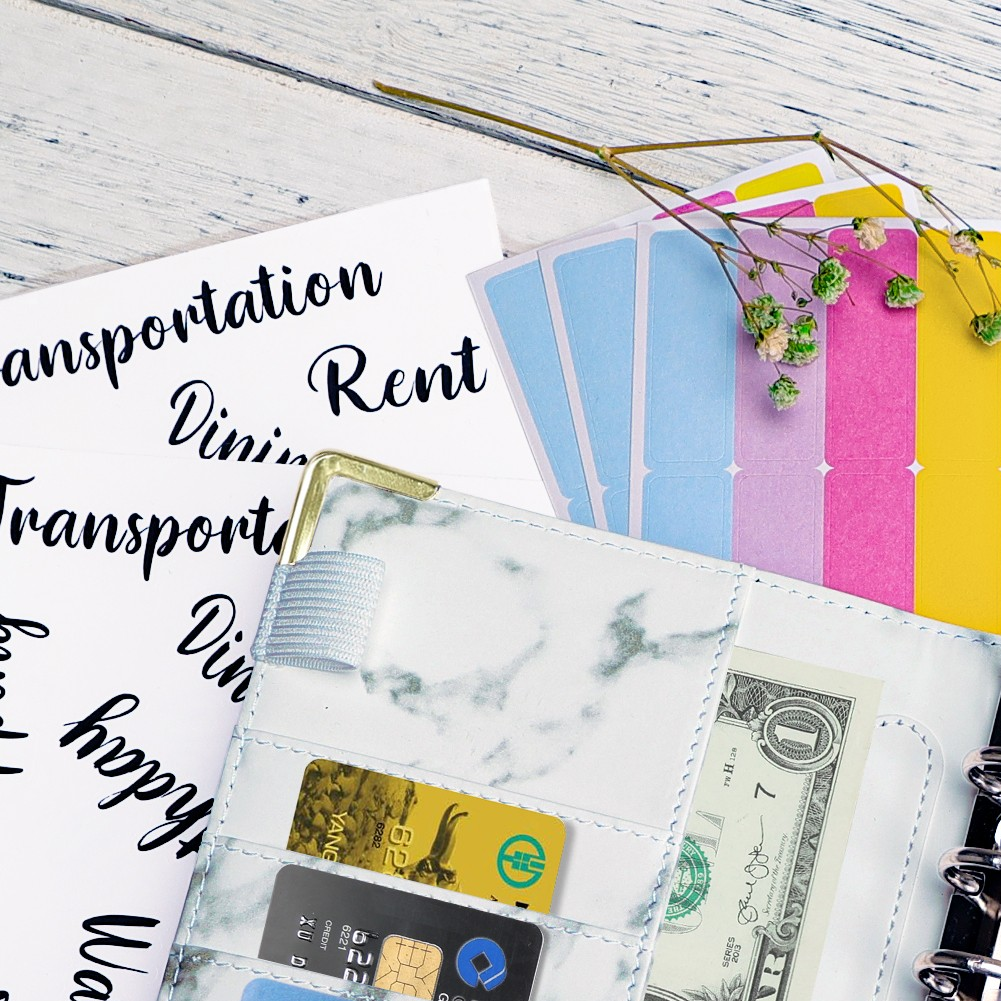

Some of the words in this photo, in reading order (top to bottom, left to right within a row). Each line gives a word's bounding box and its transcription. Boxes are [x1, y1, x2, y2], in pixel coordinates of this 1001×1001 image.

[307, 335, 487, 416] Rent
[774, 724, 820, 752] 1
[723, 762, 735, 774] H
[754, 782, 776, 799] 7
[372, 822, 385, 848] 6282
[297, 915, 318, 943] XU
[319, 920, 333, 951] CREDIT
[338, 924, 353, 952] 6221
[722, 936, 736, 968] SERIES
[731, 944, 742, 964] 2013
